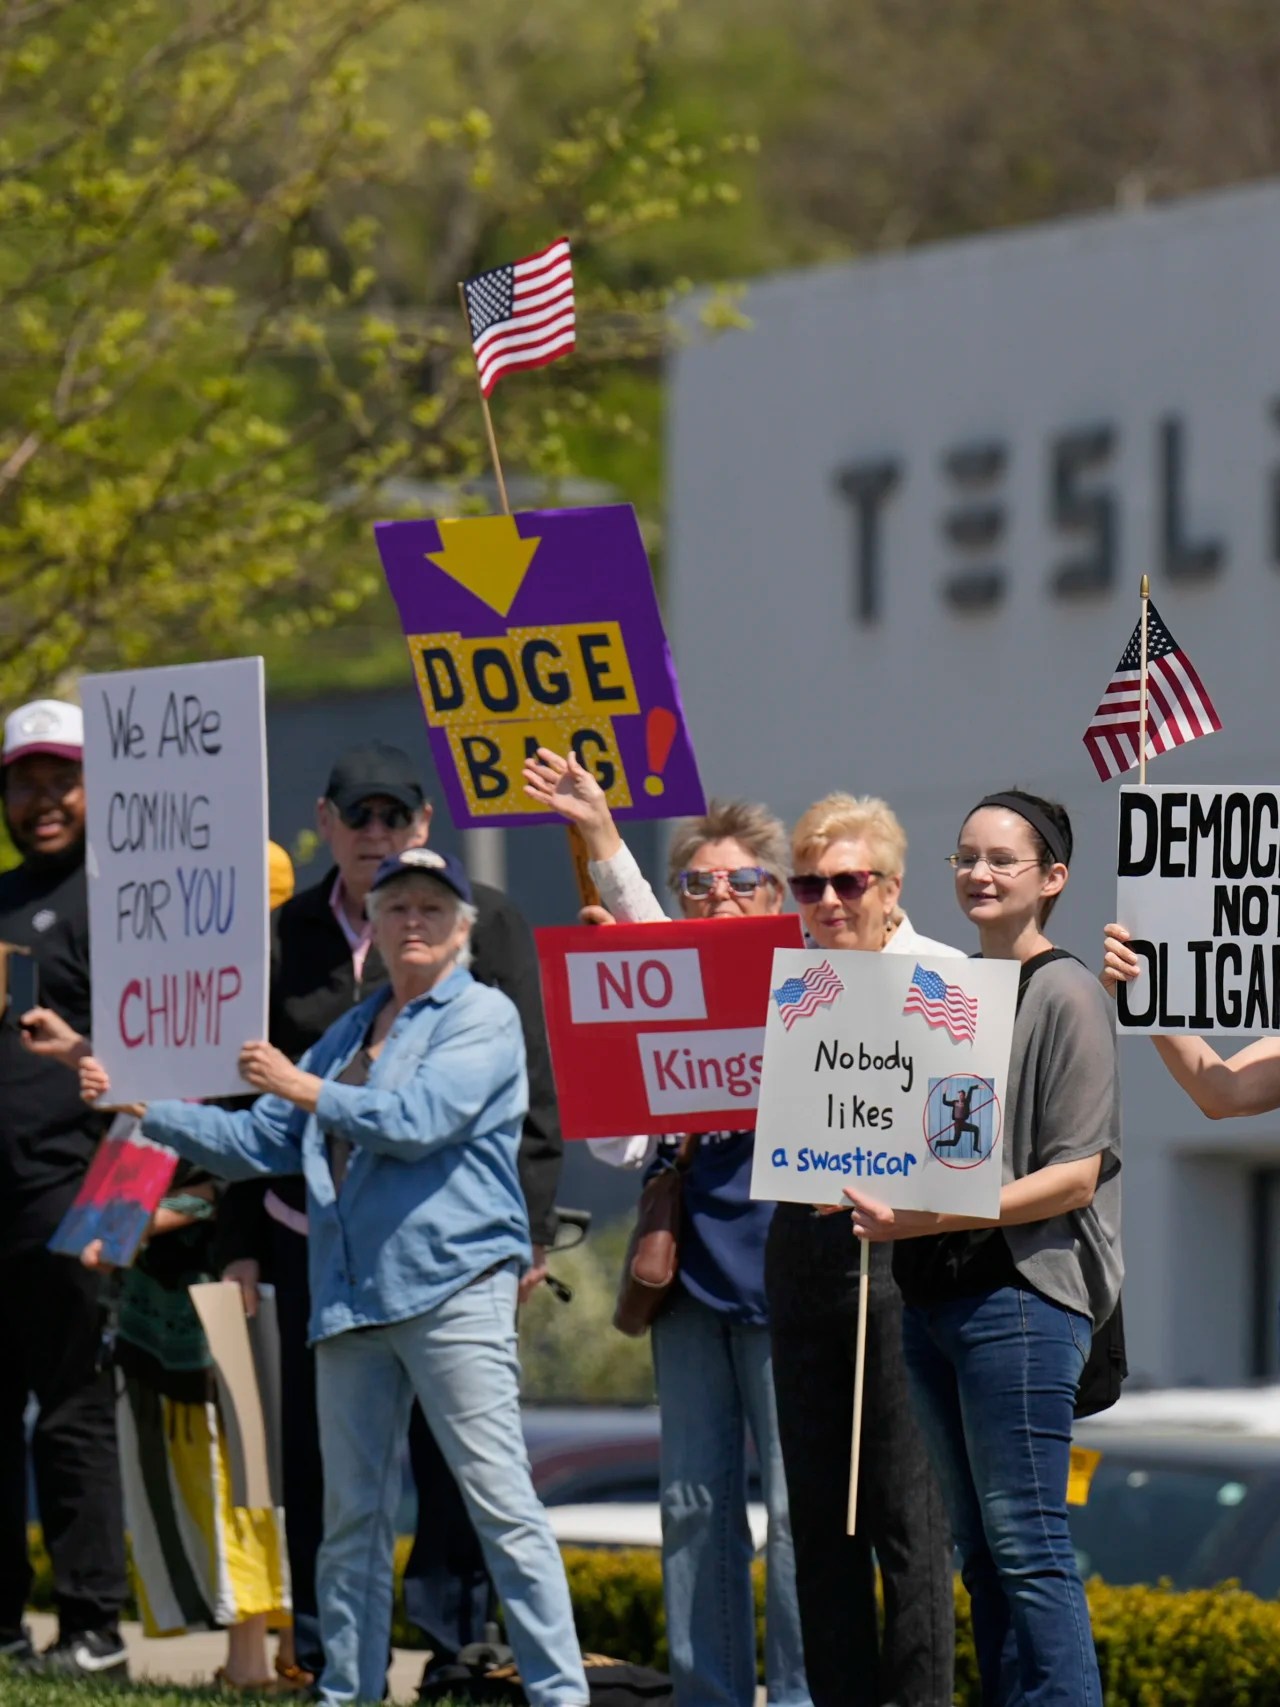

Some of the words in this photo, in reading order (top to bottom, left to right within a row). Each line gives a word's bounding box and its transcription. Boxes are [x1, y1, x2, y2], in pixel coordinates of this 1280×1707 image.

[421, 632, 627, 713] DOGE
[102, 687, 146, 759] We
[109, 791, 210, 853] COMING
[116, 879, 170, 943] FOR
[176, 866, 235, 938] YOU
[118, 966, 242, 1049] CHUMP
[596, 959, 673, 1010] NO
[653, 1048, 763, 1097] Kings
[814, 1039, 914, 1093] Nobody
[827, 1094, 893, 1130] likes
[771, 1148, 789, 1168] a
[797, 1147, 917, 1176] swasticar
